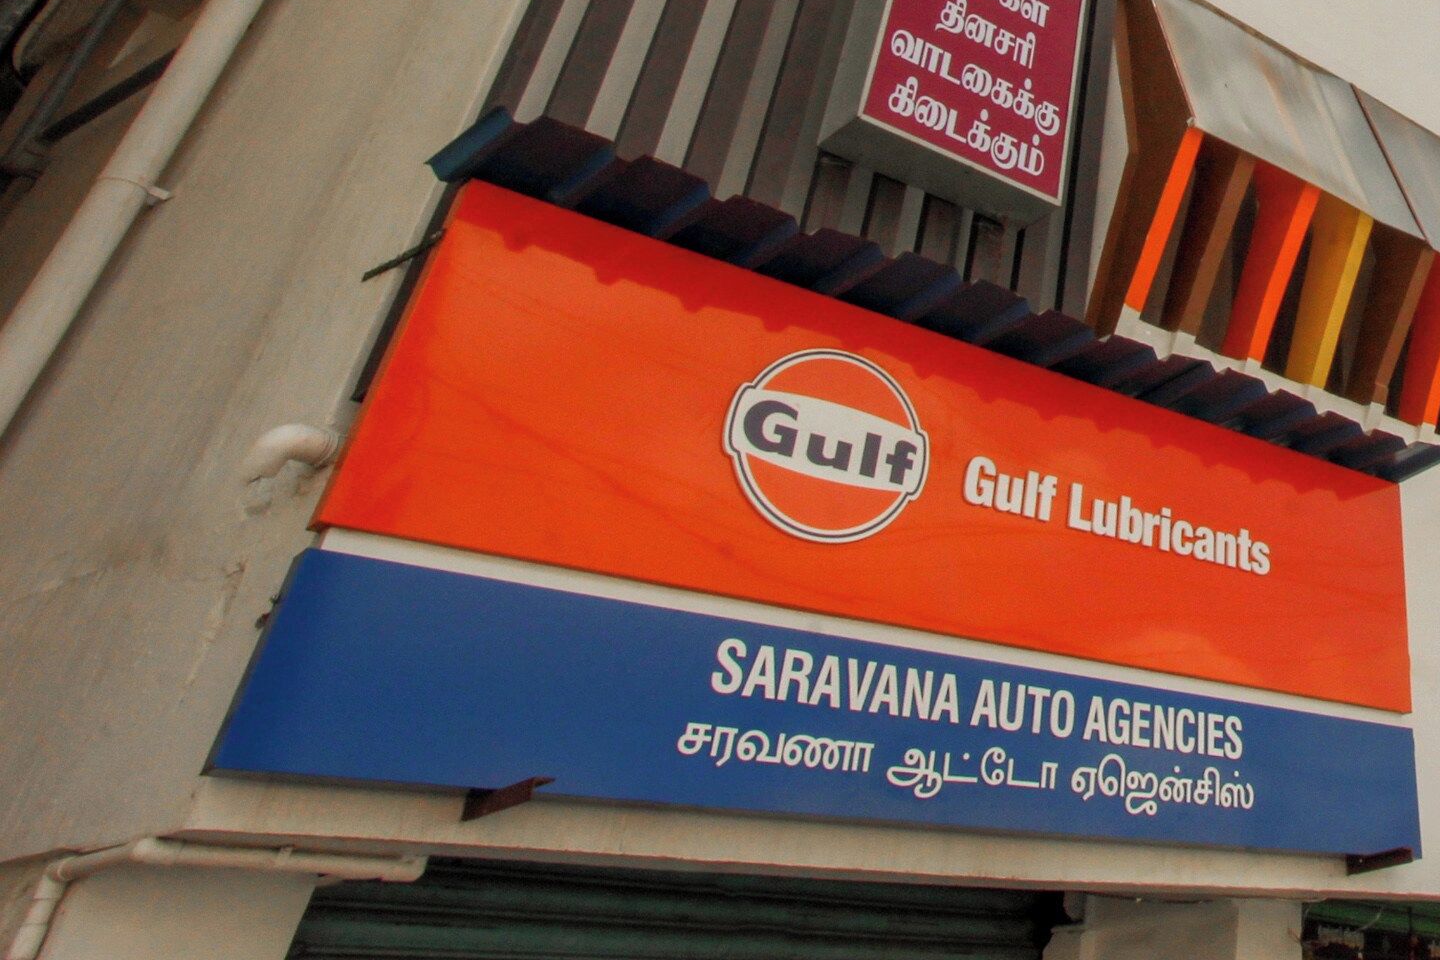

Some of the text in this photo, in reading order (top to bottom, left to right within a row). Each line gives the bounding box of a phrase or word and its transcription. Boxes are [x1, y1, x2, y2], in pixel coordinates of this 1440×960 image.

[742, 400, 918, 486] Gulf
[963, 455, 1271, 575] Gulf Lubricants
[677, 721, 875, 773] சரவணா
[711, 638, 1244, 759] SARAVANA AUTO AGENCIES
